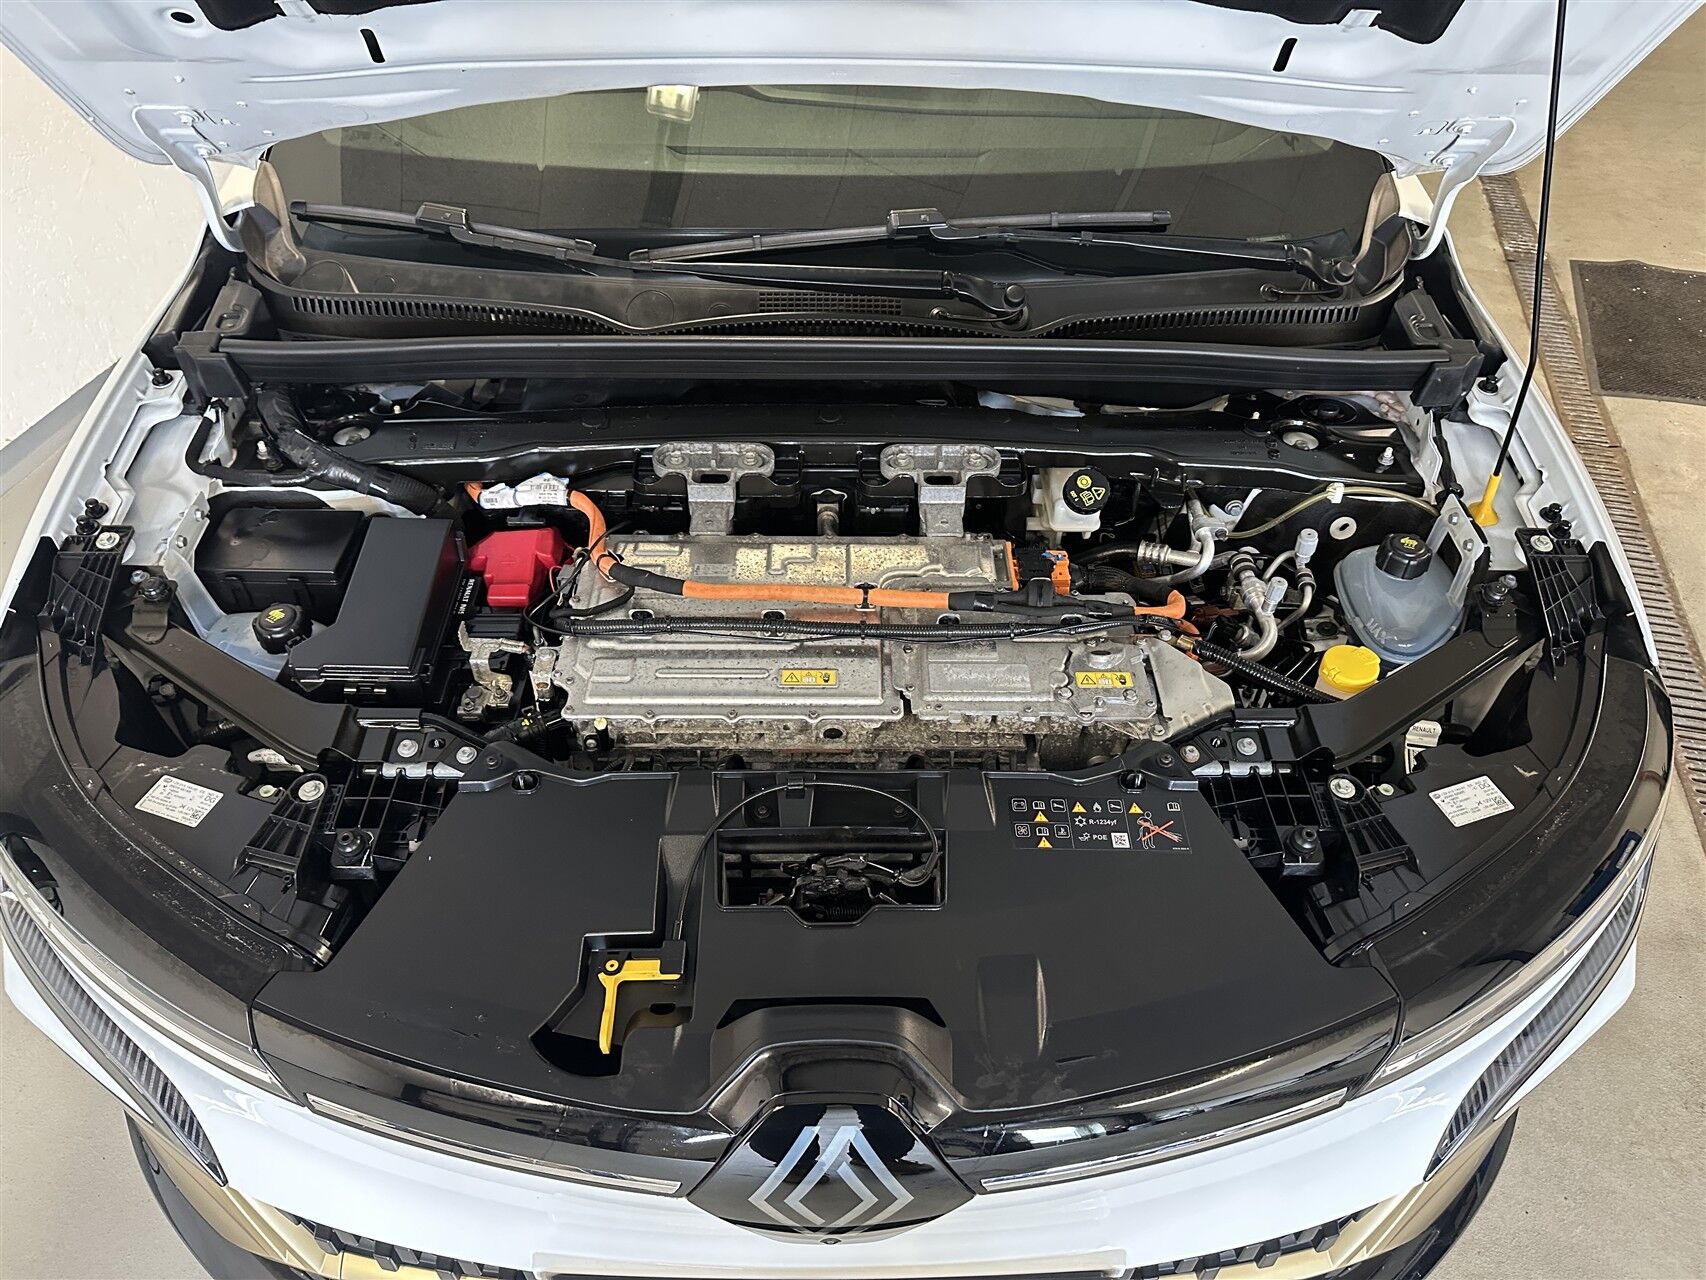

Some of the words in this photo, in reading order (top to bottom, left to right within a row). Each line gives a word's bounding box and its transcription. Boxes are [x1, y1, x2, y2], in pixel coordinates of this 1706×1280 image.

[462, 578, 475, 602] RENAULT
[1412, 725, 1437, 734] RENAULT
[1088, 818, 1117, 827] R-1234yf
